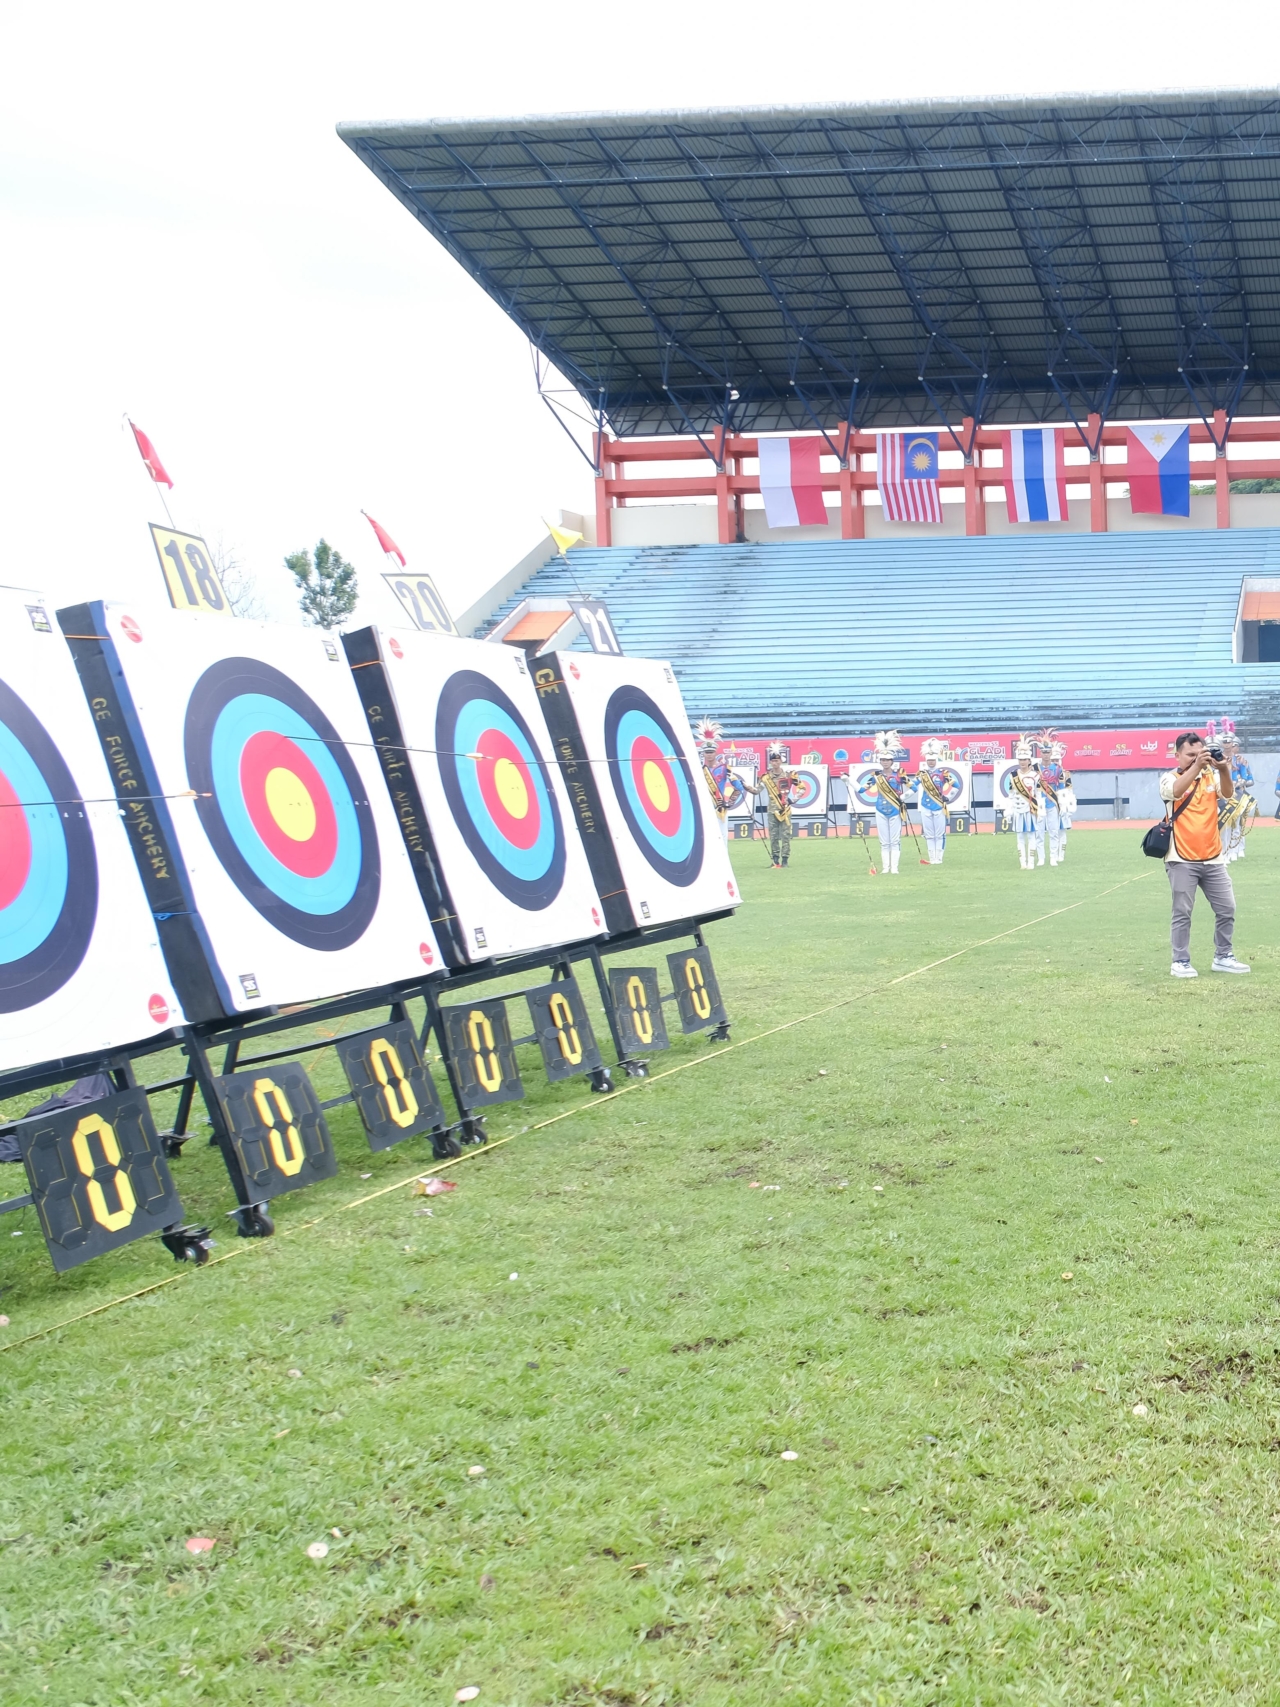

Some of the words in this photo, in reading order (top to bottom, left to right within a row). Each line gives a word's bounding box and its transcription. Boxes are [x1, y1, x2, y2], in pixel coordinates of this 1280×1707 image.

[163, 539, 224, 611] 18
[395, 581, 453, 633] 20
[579, 607, 623, 654] 21
[91, 697, 111, 721] GE
[535, 668, 560, 698] GE
[367, 705, 384, 723] GE
[803, 756, 812, 764] 12
[944, 751, 953, 761] 14
[969, 747, 1005, 755] GLADI
[395, 790, 425, 853] ARCHERY
[572, 781, 597, 834] ARCHERY
[740, 823, 748, 837] 0
[813, 822, 821, 836] 0
[957, 818, 964, 831] 0
[129, 801, 171, 879] ARCHERY
[627, 975, 653, 1044] 0
[685, 957, 711, 1020] 0
[468, 1010, 501, 1092] 0
[550, 992, 582, 1065] 0
[370, 1037, 419, 1128] 0
[254, 1077, 305, 1176] 0
[72, 1113, 137, 1232] 0
